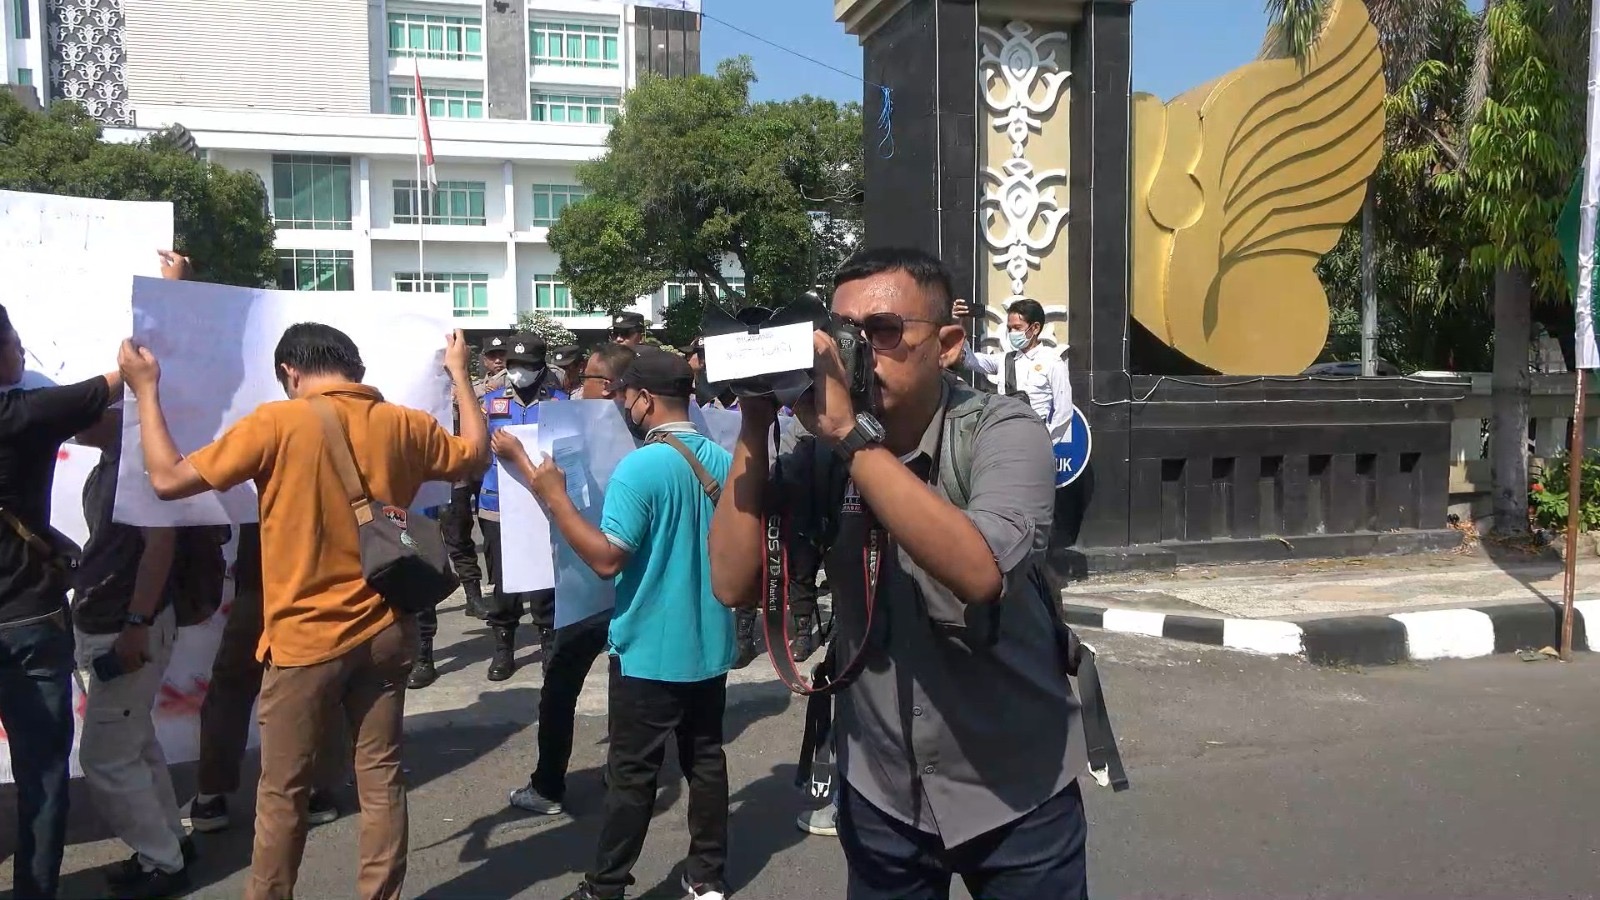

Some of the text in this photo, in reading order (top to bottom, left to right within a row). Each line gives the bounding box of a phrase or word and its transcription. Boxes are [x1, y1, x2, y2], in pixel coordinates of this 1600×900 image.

[1055, 458, 1072, 472] UK
[767, 515, 781, 551] EOS
[769, 555, 781, 576] 7D
[769, 579, 778, 604] Mark
